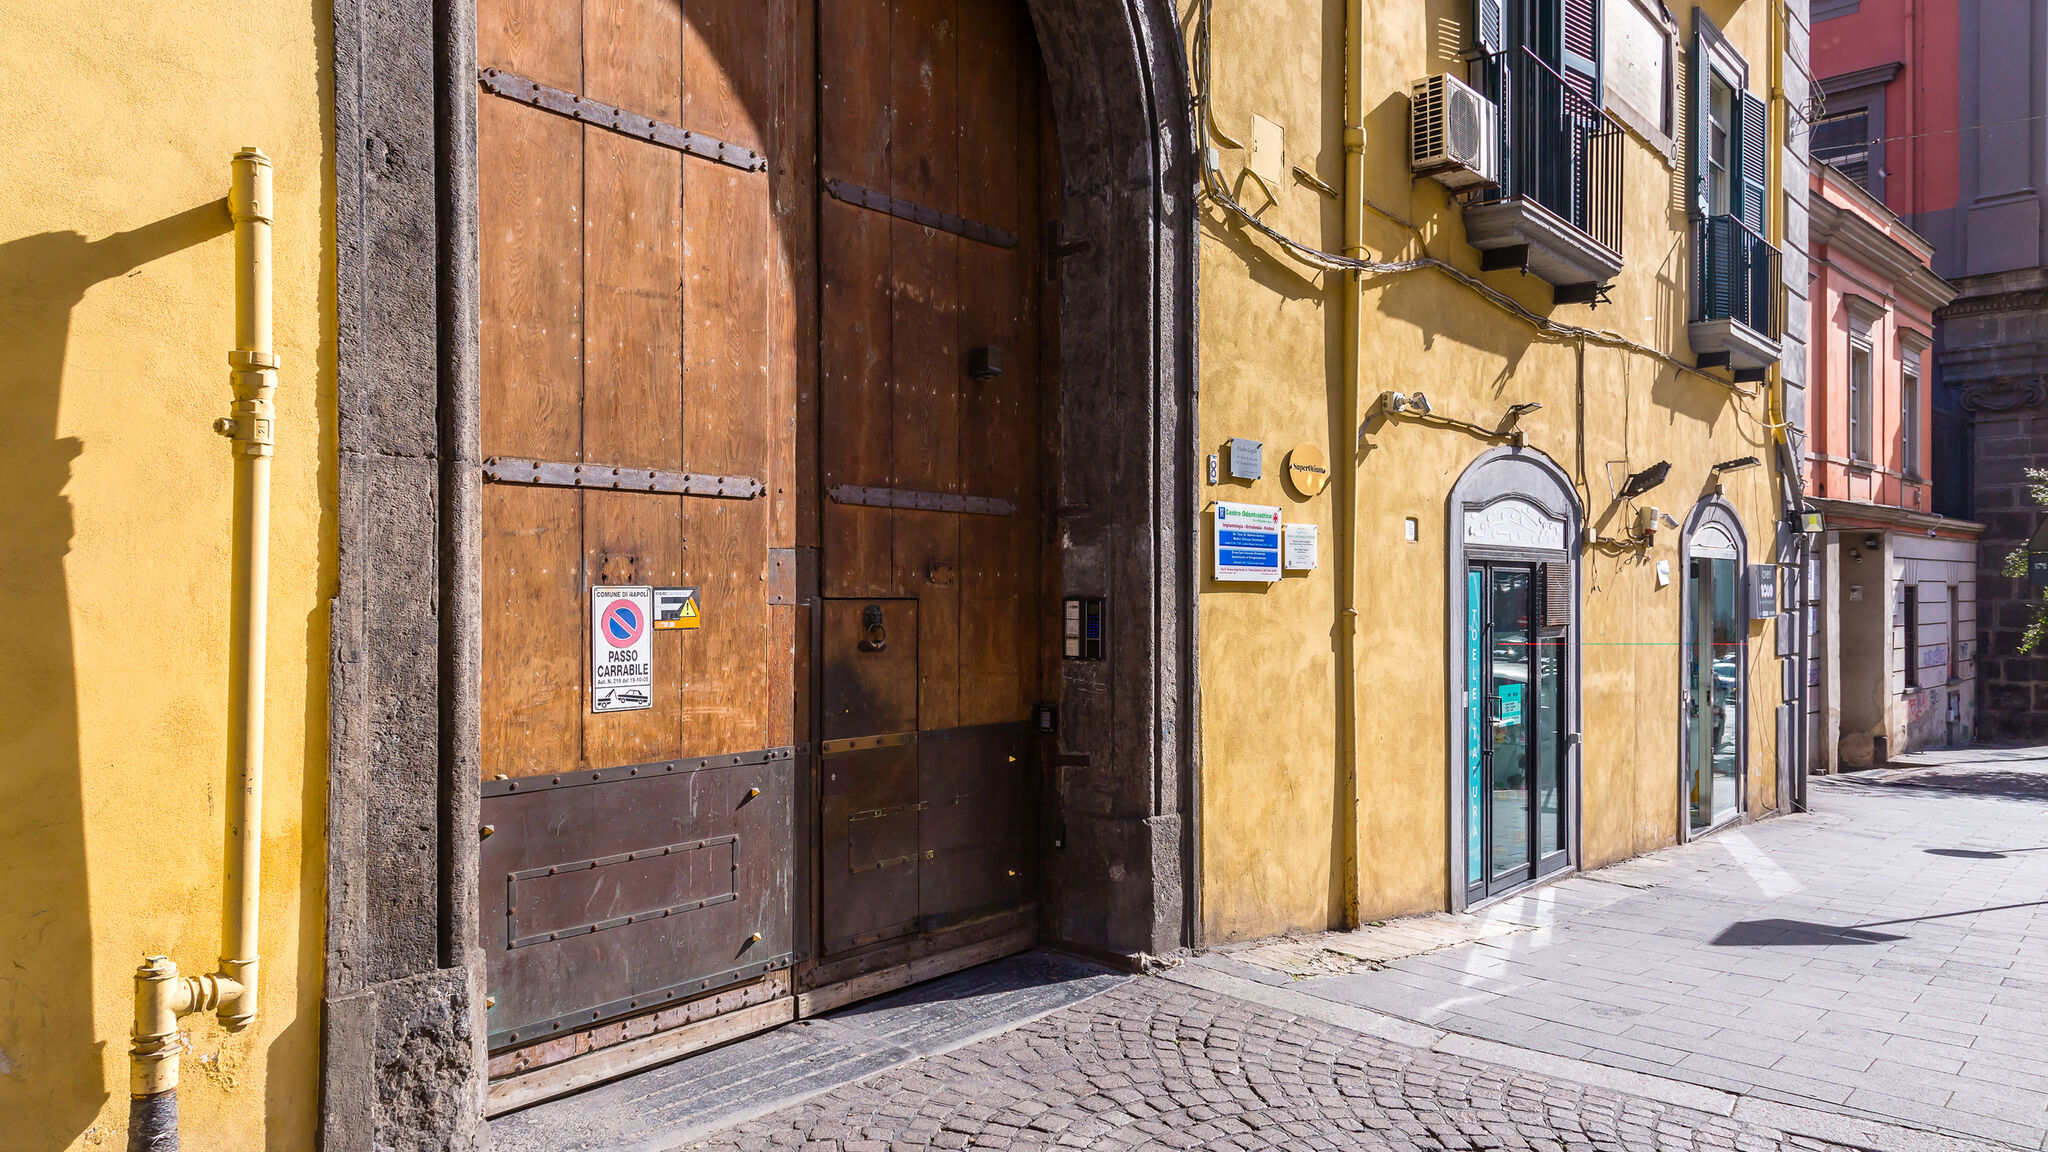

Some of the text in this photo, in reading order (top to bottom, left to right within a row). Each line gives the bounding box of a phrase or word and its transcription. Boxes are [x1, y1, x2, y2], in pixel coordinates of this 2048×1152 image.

[1242, 511, 1272, 519] Odontoiatrico
[608, 650, 638, 662] PASSO
[597, 663, 648, 678] CARRABILE
